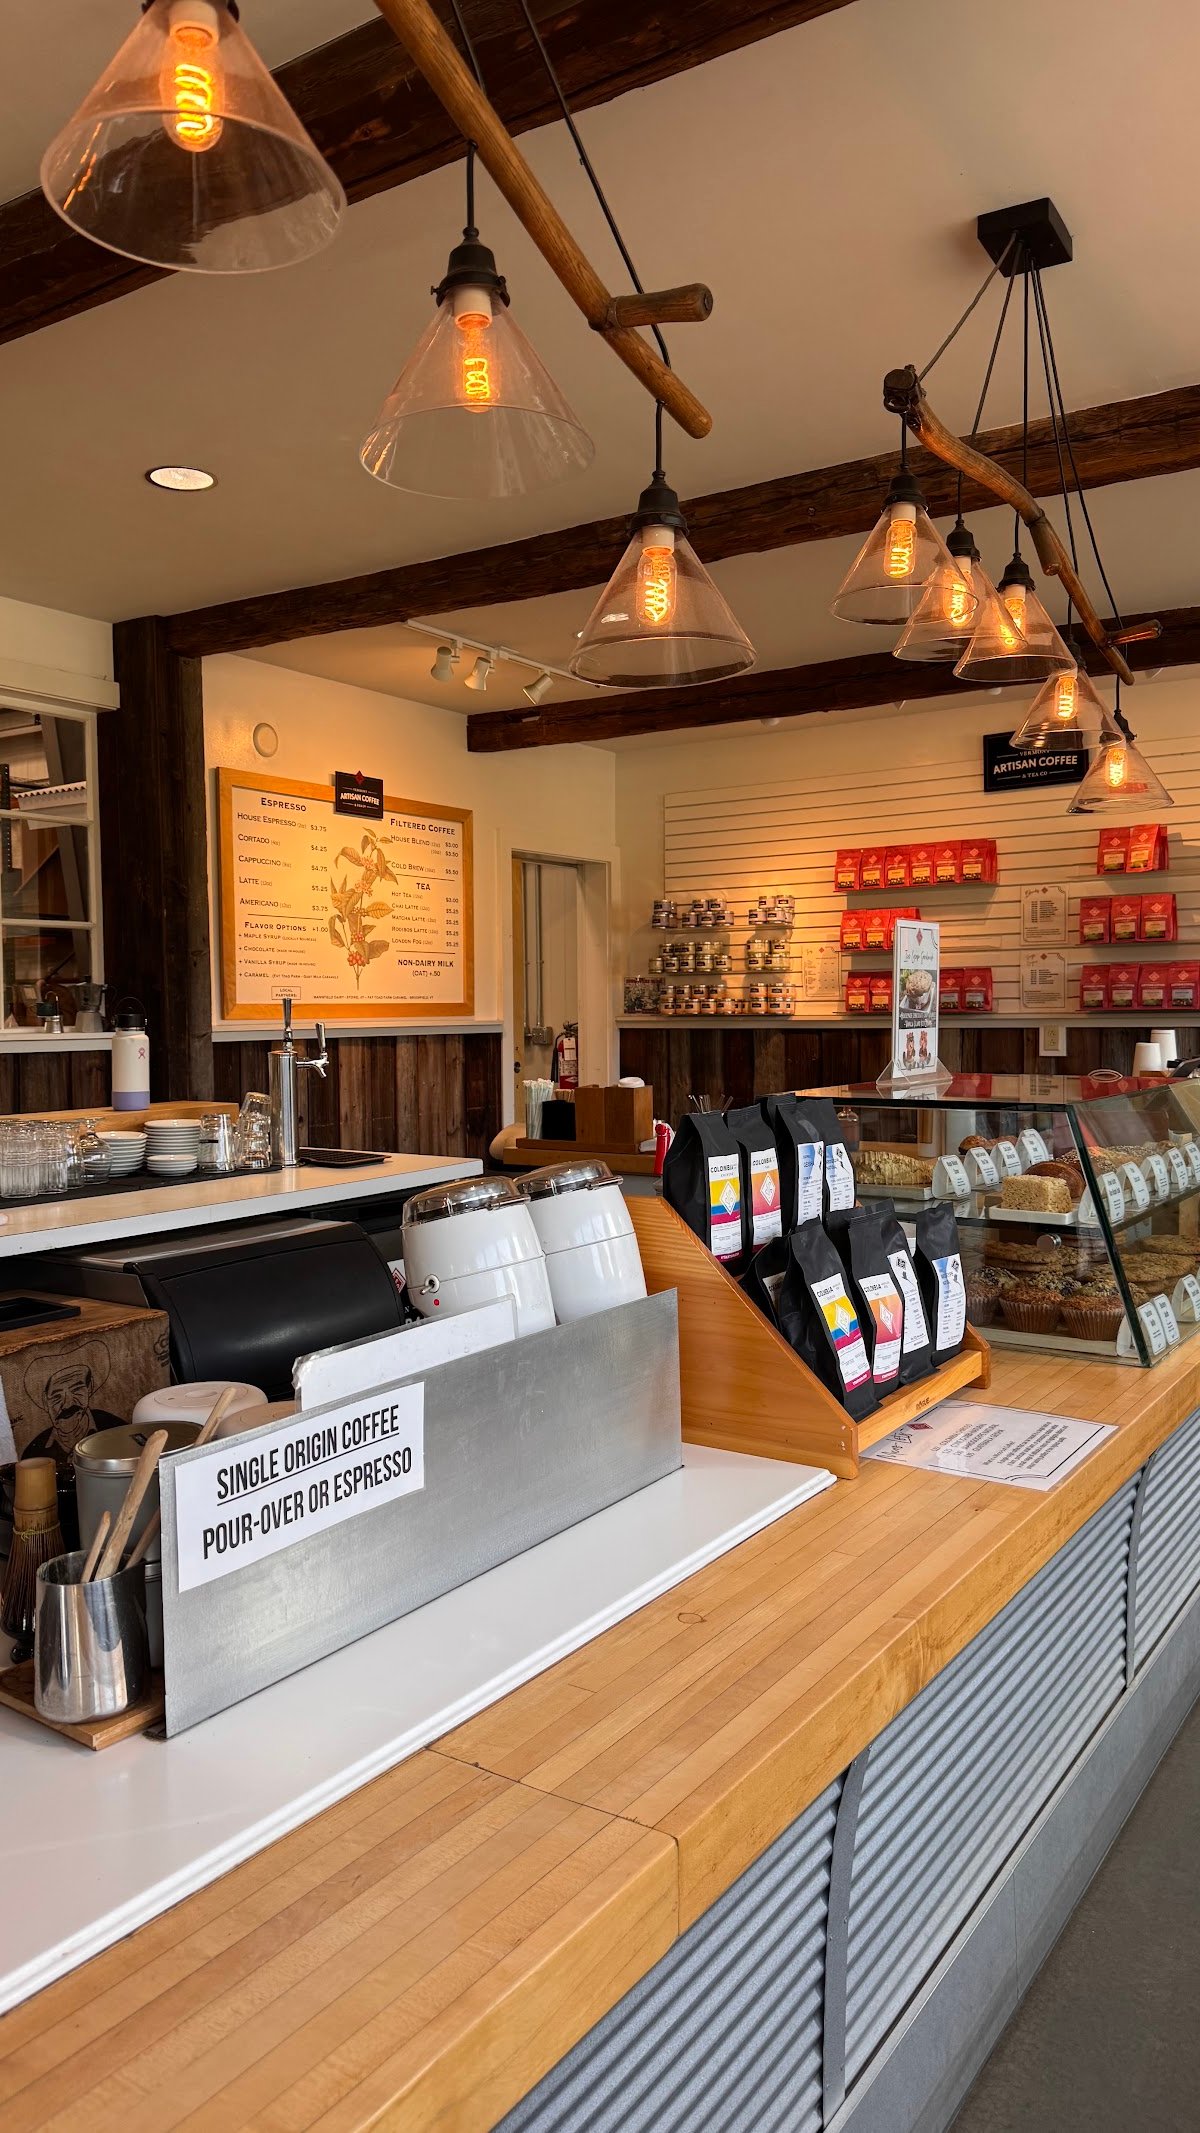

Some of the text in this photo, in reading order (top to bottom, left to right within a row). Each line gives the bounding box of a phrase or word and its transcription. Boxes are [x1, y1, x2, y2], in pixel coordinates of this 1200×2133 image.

[993, 755, 1078, 775] ARTISAN COFFEE
[261, 797, 307, 811] ESPRESSO
[340, 792, 380, 805] ARTISAN COFFEE
[237, 812, 261, 822] HOUSE
[263, 816, 296, 827] ESPRESSO
[390, 818, 455, 835] FILTERED COFFEE
[238, 834, 270, 844] CORTADO
[391, 835, 410, 844] HOUSE
[411, 838, 430, 846] BLEND
[238, 855, 281, 866] CAPPUCCINO
[391, 862, 407, 870] COLD
[408, 863, 424, 872] BREW
[239, 876, 259, 885] LATTE
[416, 882, 431, 891] TEA
[239, 898, 279, 907] AMERICANO
[244, 922, 274, 930] FLAVOR
[276, 924, 307, 932] OPTIONS
[398, 959, 454, 968] NON-DAIRY MILK
[216, 1404, 399, 1500] SINGLE ORIGIN COFFEE
[203, 1446, 412, 1560] POUR-OVER OR ESPRESSO
